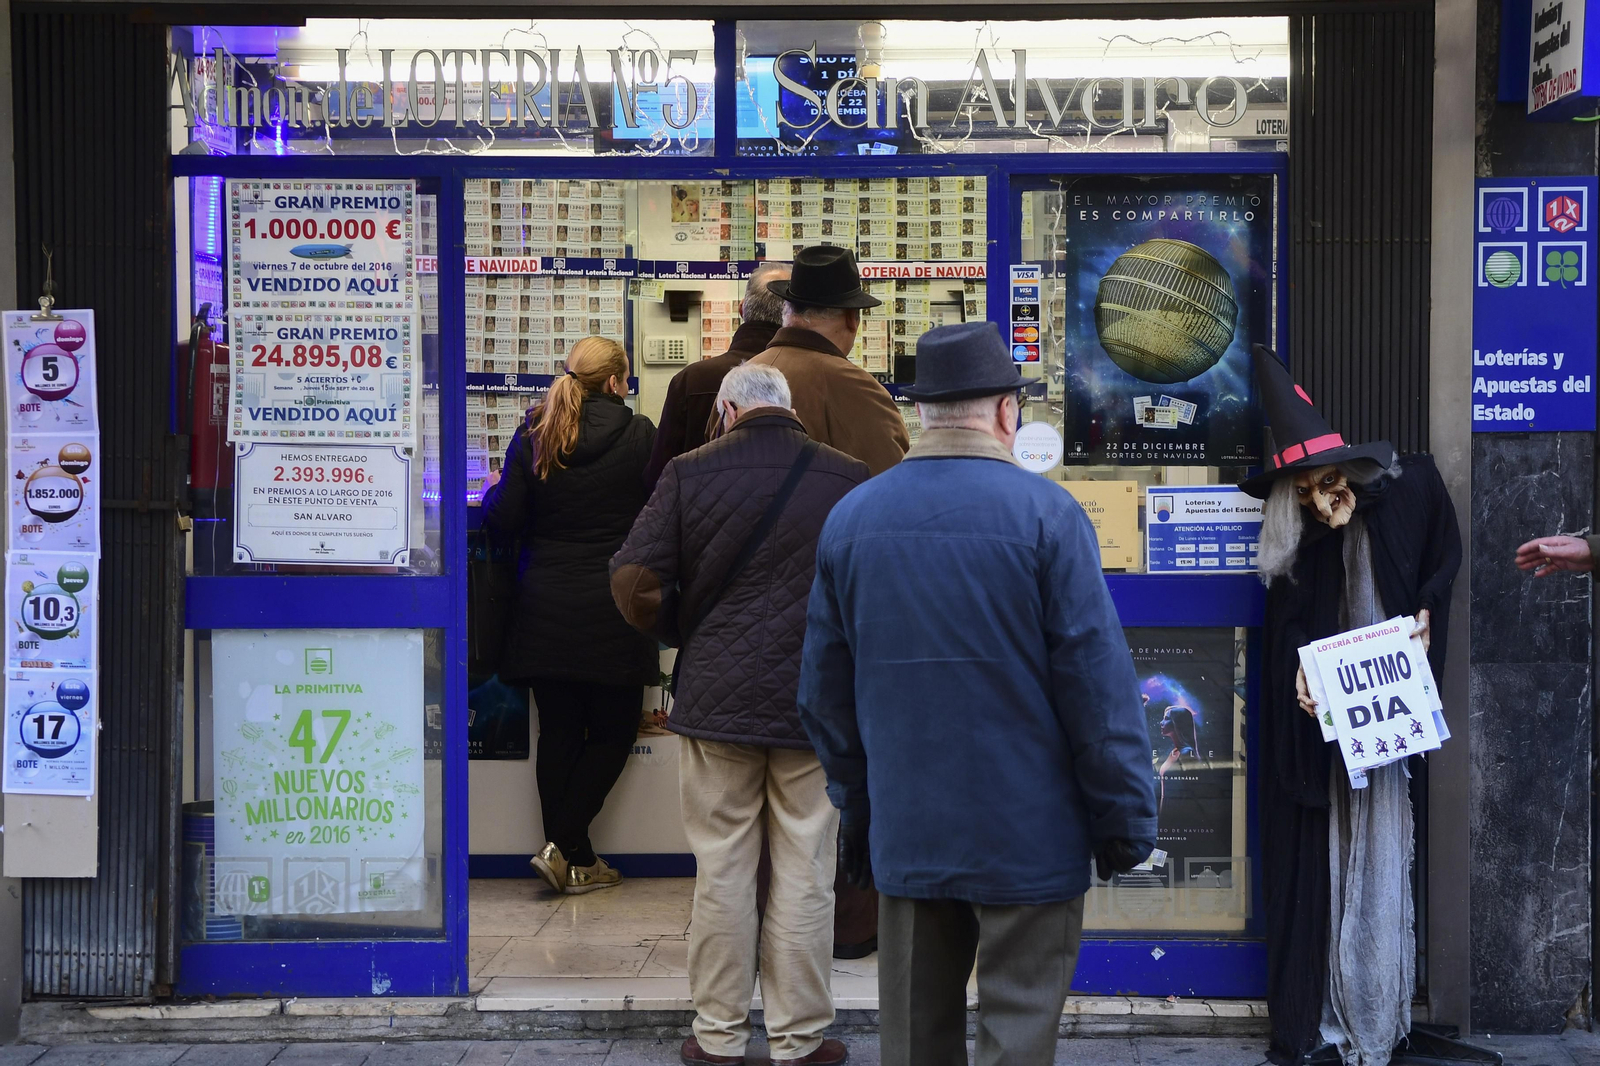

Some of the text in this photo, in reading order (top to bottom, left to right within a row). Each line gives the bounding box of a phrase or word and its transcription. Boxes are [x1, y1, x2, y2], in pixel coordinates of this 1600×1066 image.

[378, 45, 600, 128] LOTERIA
[773, 39, 1248, 130] San Alvaro
[274, 195, 401, 210] GRAN PREMIO
[1074, 195, 1261, 207] EL MAYOR PREMIO
[1079, 210, 1255, 222] ES COMPARTIRLO
[244, 218, 402, 240] 1.000.000 €
[253, 262, 392, 271] viernes 7 de octubre del 2016
[479, 259, 538, 273] NAVIDAD
[859, 265, 987, 278] OTERIA DE NAVIDA
[1016, 271, 1035, 279] VISA
[247, 273, 399, 296] VENDIDO AQUÍ
[277, 327, 398, 341] GRAN PREMIO
[251, 344, 398, 373] 24.895,08 €
[1473, 348, 1565, 370] Loterías y
[42, 356, 59, 382] 5
[304, 376, 348, 384] ACIERTOS
[1472, 375, 1591, 398] Apuestas del
[20, 403, 41, 412] BOTE
[248, 403, 397, 425] VENDIDO AQUÍ
[1473, 402, 1536, 421] Estado
[1106, 442, 1206, 451] 22 DE DICIEMBRE
[280, 453, 368, 463] HEMOS ENTREGADO
[1020, 450, 1054, 463] Google
[1163, 452, 1206, 460] NAVIDAD
[273, 466, 366, 483] 2.393.996
[27, 488, 80, 499] 1.852.000
[253, 487, 393, 498] EN PREMIOS A LO LARGO DE 2016
[268, 496, 378, 507] EN ESTE PUNTO DE VENTA
[293, 512, 353, 522] SAN ALVARO
[1185, 507, 1220, 515] Apuestas
[1235, 506, 1261, 514] Estado
[22, 524, 43, 533] BOTE
[29, 596, 75, 624] 10,3
[18, 640, 40, 650] BOTE
[1317, 625, 1401, 653] LOTERÍA DE NAVIDAD
[1336, 650, 1412, 695] ÚLTIMO
[274, 683, 364, 695] LA PRIMITIVA
[1346, 694, 1413, 730] DÍA
[32, 714, 66, 740] 17
[288, 709, 352, 764] 47
[16, 759, 38, 769] BOTE
[273, 769, 366, 795] NUEVOS
[245, 796, 395, 826] MILLONARIOS
[285, 825, 351, 844] en 2016
